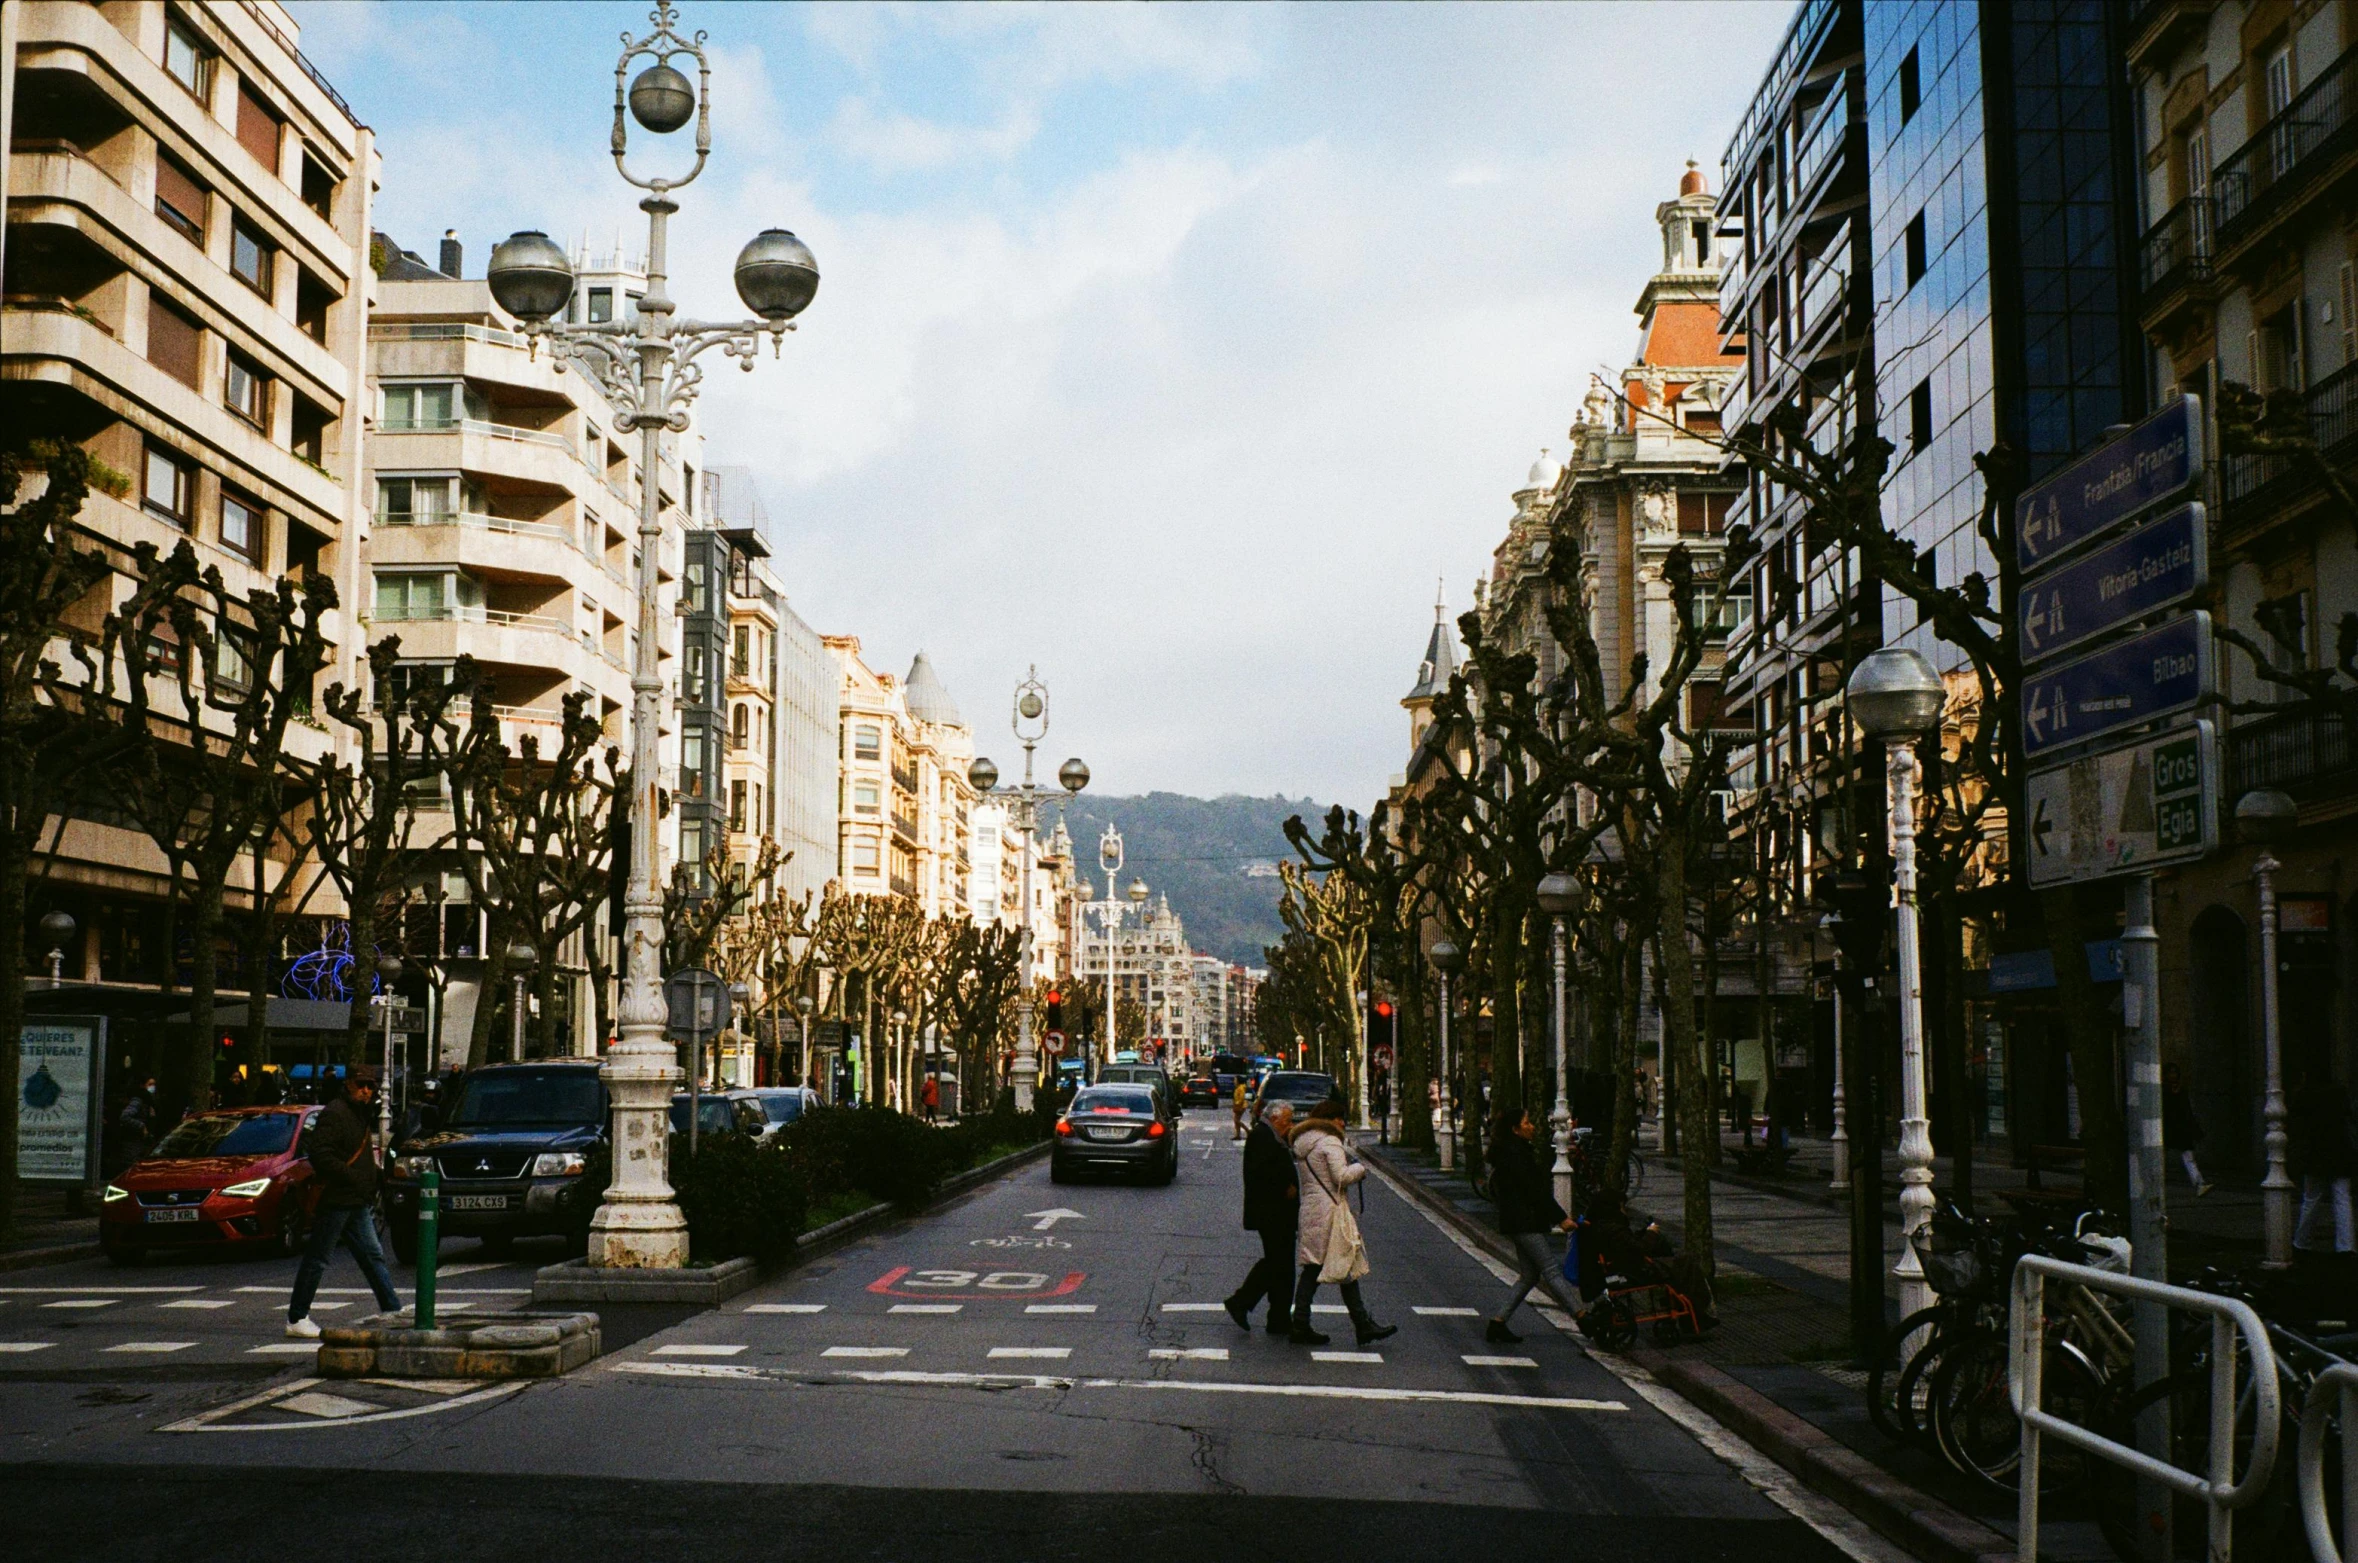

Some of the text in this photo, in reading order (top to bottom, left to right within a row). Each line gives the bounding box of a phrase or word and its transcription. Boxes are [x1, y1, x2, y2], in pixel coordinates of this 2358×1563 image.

[2084, 434, 2185, 509] Frantzia/Francia
[2099, 540, 2191, 602] Vitoria-Gasteiz
[2153, 653, 2196, 684] Bilbao
[2156, 753, 2196, 788] Gros
[2159, 801, 2196, 844] Egia
[20, 1142, 73, 1152] promedios
[455, 1197, 504, 1208] 3124 CXS
[903, 1269, 1049, 1289] 30
